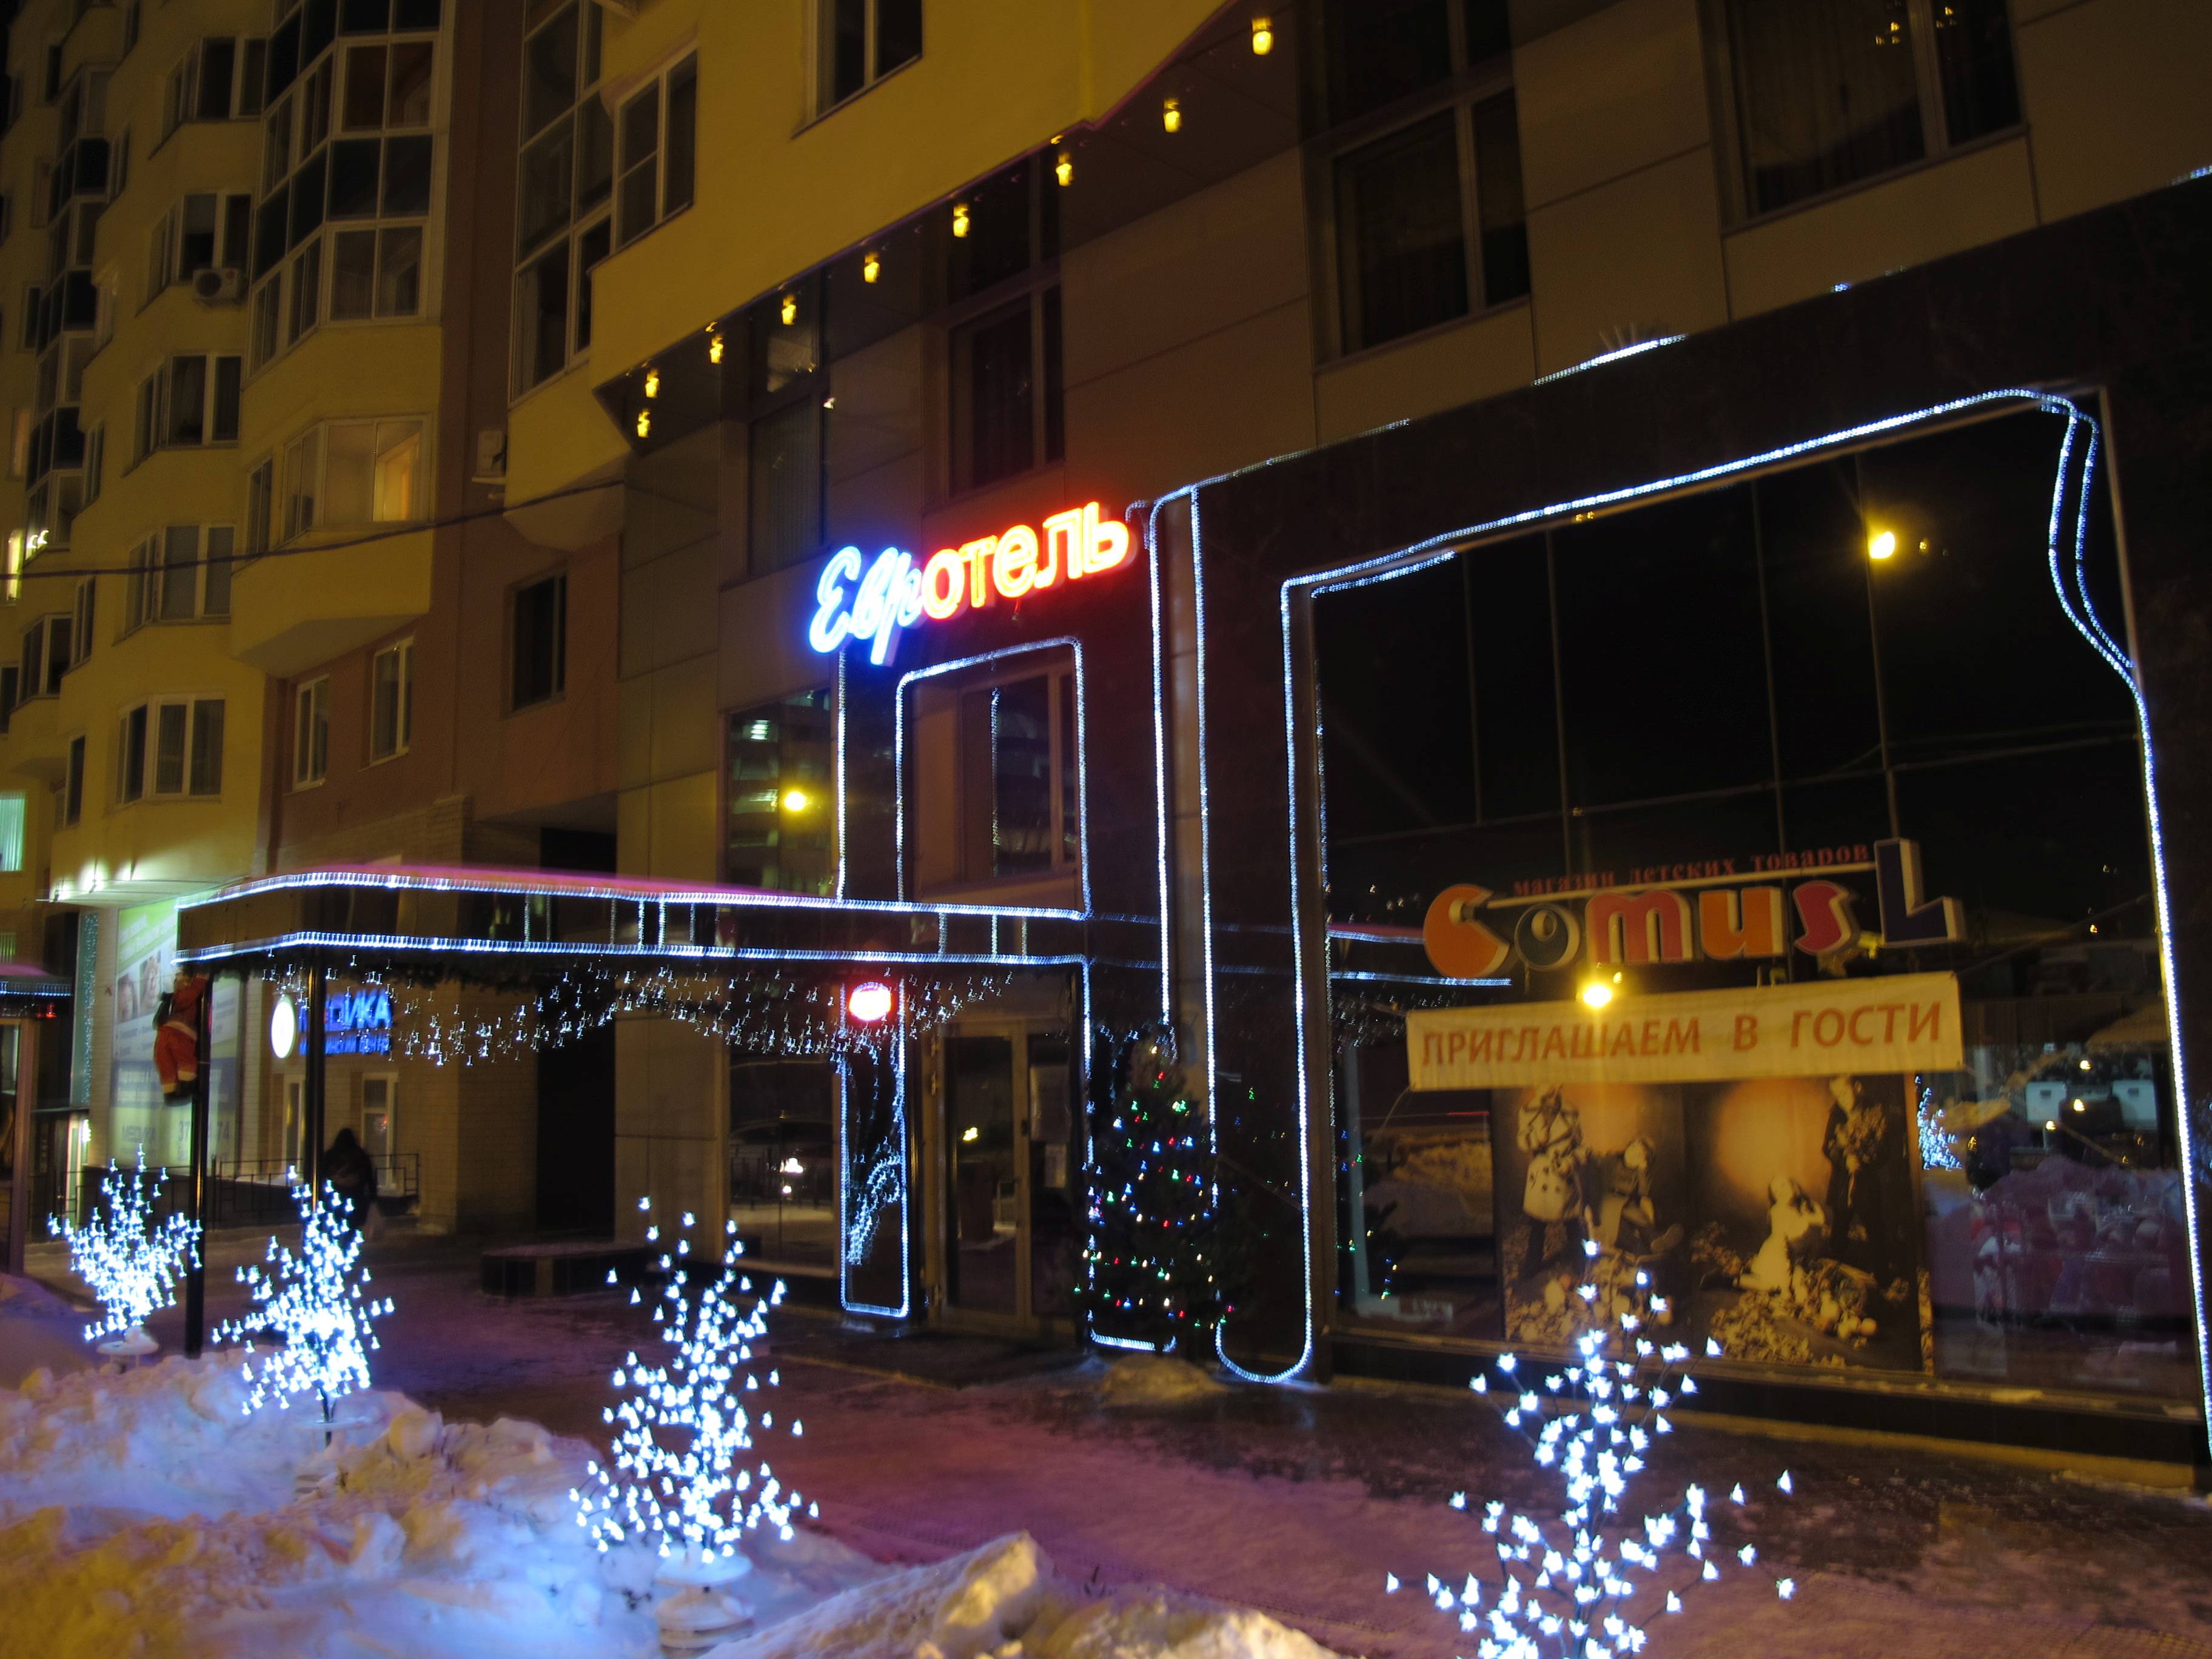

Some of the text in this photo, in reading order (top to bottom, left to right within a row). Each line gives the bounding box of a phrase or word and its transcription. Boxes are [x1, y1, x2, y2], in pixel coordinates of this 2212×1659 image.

[1422, 1002, 1942, 1067] ПРИГЛАШАЕМ В ГОСТИ
